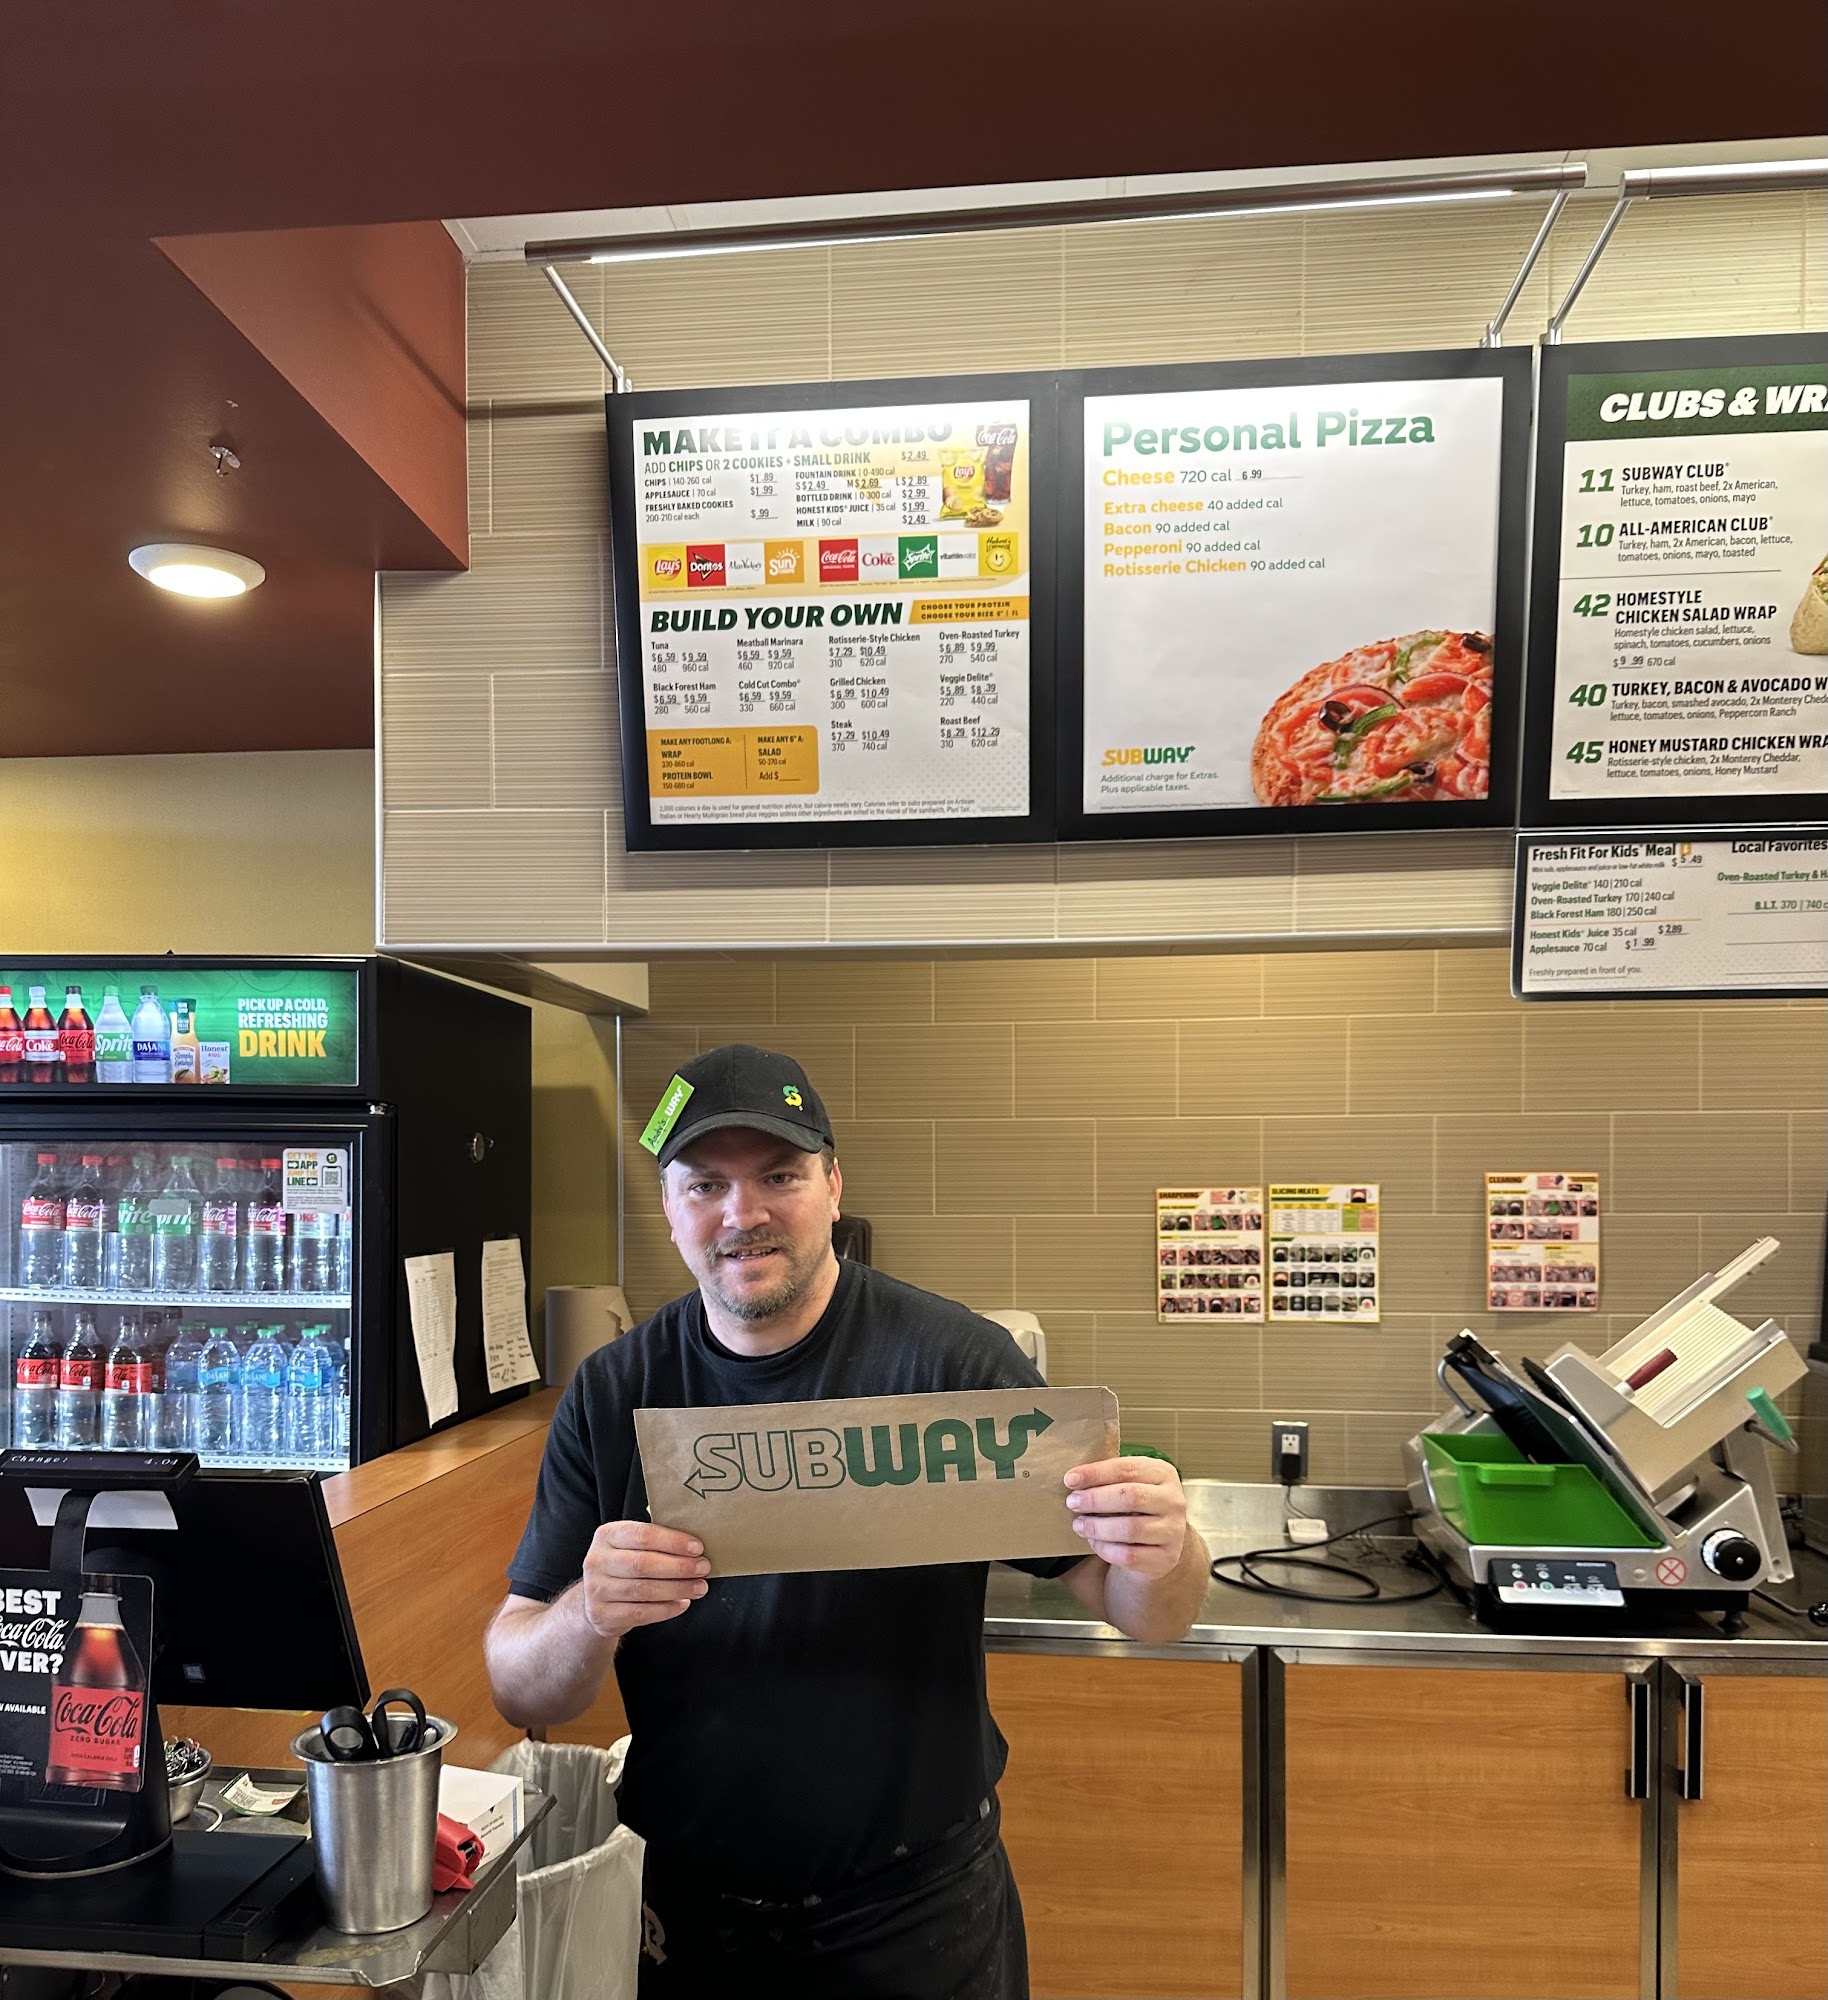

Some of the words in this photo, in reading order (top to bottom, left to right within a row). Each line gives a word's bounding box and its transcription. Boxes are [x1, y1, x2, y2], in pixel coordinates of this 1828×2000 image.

[1600, 389, 1726, 422] CLUBS
[1728, 387, 1759, 416] &
[1103, 411, 1301, 456] Personal
[1316, 408, 1435, 447] Pizza
[643, 428, 742, 455] MAKE
[645, 462, 666, 474] ADD
[669, 460, 703, 472] CHIPS
[706, 460, 720, 470] OR
[723, 459, 730, 469] 2
[733, 456, 783, 469] COOKIES
[794, 454, 831, 466] SMALL
[834, 452, 871, 464] DRINK
[796, 471, 831, 479] FOUNTAIN
[833, 469, 856, 478] DRINK
[885, 467, 895, 475] cal
[1103, 469, 1175, 486] Cheese
[1180, 470, 1206, 483] 720
[1211, 469, 1232, 482] cal
[1578, 468, 1614, 493] 11
[1622, 465, 1683, 481] SUBWAY
[645, 479, 666, 487] CHIPS
[702, 476, 712, 484] cal
[1622, 485, 1651, 496] Turkey,
[1653, 484, 1674, 494] ham,
[1676, 483, 1698, 492] roast
[1700, 482, 1720, 492] beef,
[1723, 481, 1733, 490] 2x
[1735, 480, 1778, 490] American,
[645, 490, 690, 499] APPLESAUCE
[698, 489, 705, 497] 70
[1621, 497, 1652, 507] lettuce,
[1655, 496, 1697, 506] tomatoes,
[1700, 495, 1730, 504] onions,
[1732, 494, 1756, 503] mayo
[646, 503, 675, 512] FRESHLY
[677, 502, 700, 510] BAKED
[701, 501, 733, 509] COOKIES
[1104, 502, 1146, 515] Extra
[1151, 499, 1203, 513] cheese
[1208, 500, 1223, 511] 40
[1226, 499, 1263, 511] added
[1266, 498, 1283, 509] cal
[797, 519, 814, 527] MILK
[822, 518, 830, 526] 90
[832, 518, 841, 526] cal
[1104, 522, 1151, 536] Bacon
[1155, 523, 1171, 534] 90
[1174, 521, 1210, 533] added
[1213, 520, 1230, 532] cal
[1619, 519, 1726, 537] ALL-AMERICAN
[1576, 523, 1615, 548] 10
[1104, 540, 1182, 558] Pepperoni
[1186, 542, 1201, 553] 90
[1204, 541, 1241, 552] added
[1244, 540, 1260, 551] cal
[690, 560, 723, 572] Doritos
[862, 553, 895, 566] Coke
[1104, 562, 1181, 577] Rotisserie
[1186, 559, 1246, 573] Chicken
[1250, 560, 1265, 572] 90
[1269, 559, 1305, 570] added
[1309, 558, 1325, 569] cal
[1573, 594, 1611, 617] 42
[1616, 590, 1702, 606] HOMESTYLE
[651, 609, 738, 632] BUILD
[745, 606, 824, 630] YOUR
[830, 602, 903, 626] OWN
[1616, 608, 1680, 624] CHICKEN
[1683, 607, 1730, 622] SALAD
[1734, 605, 1777, 621] WRAP
[737, 638, 769, 647] Meatball
[770, 638, 803, 646] Marinara
[828, 635, 889, 645] Rotisserie-Style
[890, 633, 920, 642] Chicken
[939, 631, 993, 640] Oven-Roasted
[995, 630, 1019, 639] Turkey
[654, 683, 673, 691] Black
[675, 682, 698, 690] Forest
[700, 682, 716, 690] Ham
[830, 678, 855, 686] Grilled
[856, 677, 886, 685] Chicken
[1612, 682, 1670, 698] TURKEY,
[1675, 680, 1724, 694] BACON
[1727, 679, 1737, 693] &
[1741, 677, 1811, 693] AVOCADO
[1569, 683, 1607, 707] 40
[831, 720, 852, 729] Steak
[941, 717, 961, 725] Roast
[963, 716, 980, 724] Beef
[758, 748, 781, 756] SALAD
[1566, 741, 1603, 763] 45
[1609, 739, 1657, 754] HONEY
[1660, 738, 1728, 752] MUSTARD
[1731, 736, 1796, 751] CHICKEN
[1101, 745, 1196, 766] SUBWAY
[663, 772, 692, 780] PROTEIN
[693, 771, 713, 779] BOWL
[1101, 773, 1144, 782] Additional
[1146, 774, 1174, 782] charge
[1533, 848, 1567, 861] Fresh
[1570, 847, 1586, 859] Fit
[1588, 846, 1608, 858] For
[1646, 844, 1675, 856] Meal
[1732, 841, 1766, 853] Local
[1768, 840, 1828, 852] Favorites
[238, 998, 266, 1011] PICK
[267, 998, 283, 1011] UP
[285, 998, 293, 1011] A
[294, 998, 329, 1012] COLD,
[238, 1013, 328, 1028] REFRESHING
[26, 1040, 54, 1052] Coke
[239, 1030, 326, 1057] DRINK
[664, 1085, 684, 1116] WAY
[301, 1161, 318, 1169] APP
[288, 1177, 305, 1185] LINE
[683, 1406, 1054, 1499] SUBWAY
[5, 1705, 47, 1715] AVAILABLE
[94, 1737, 120, 1746] SUGAR
